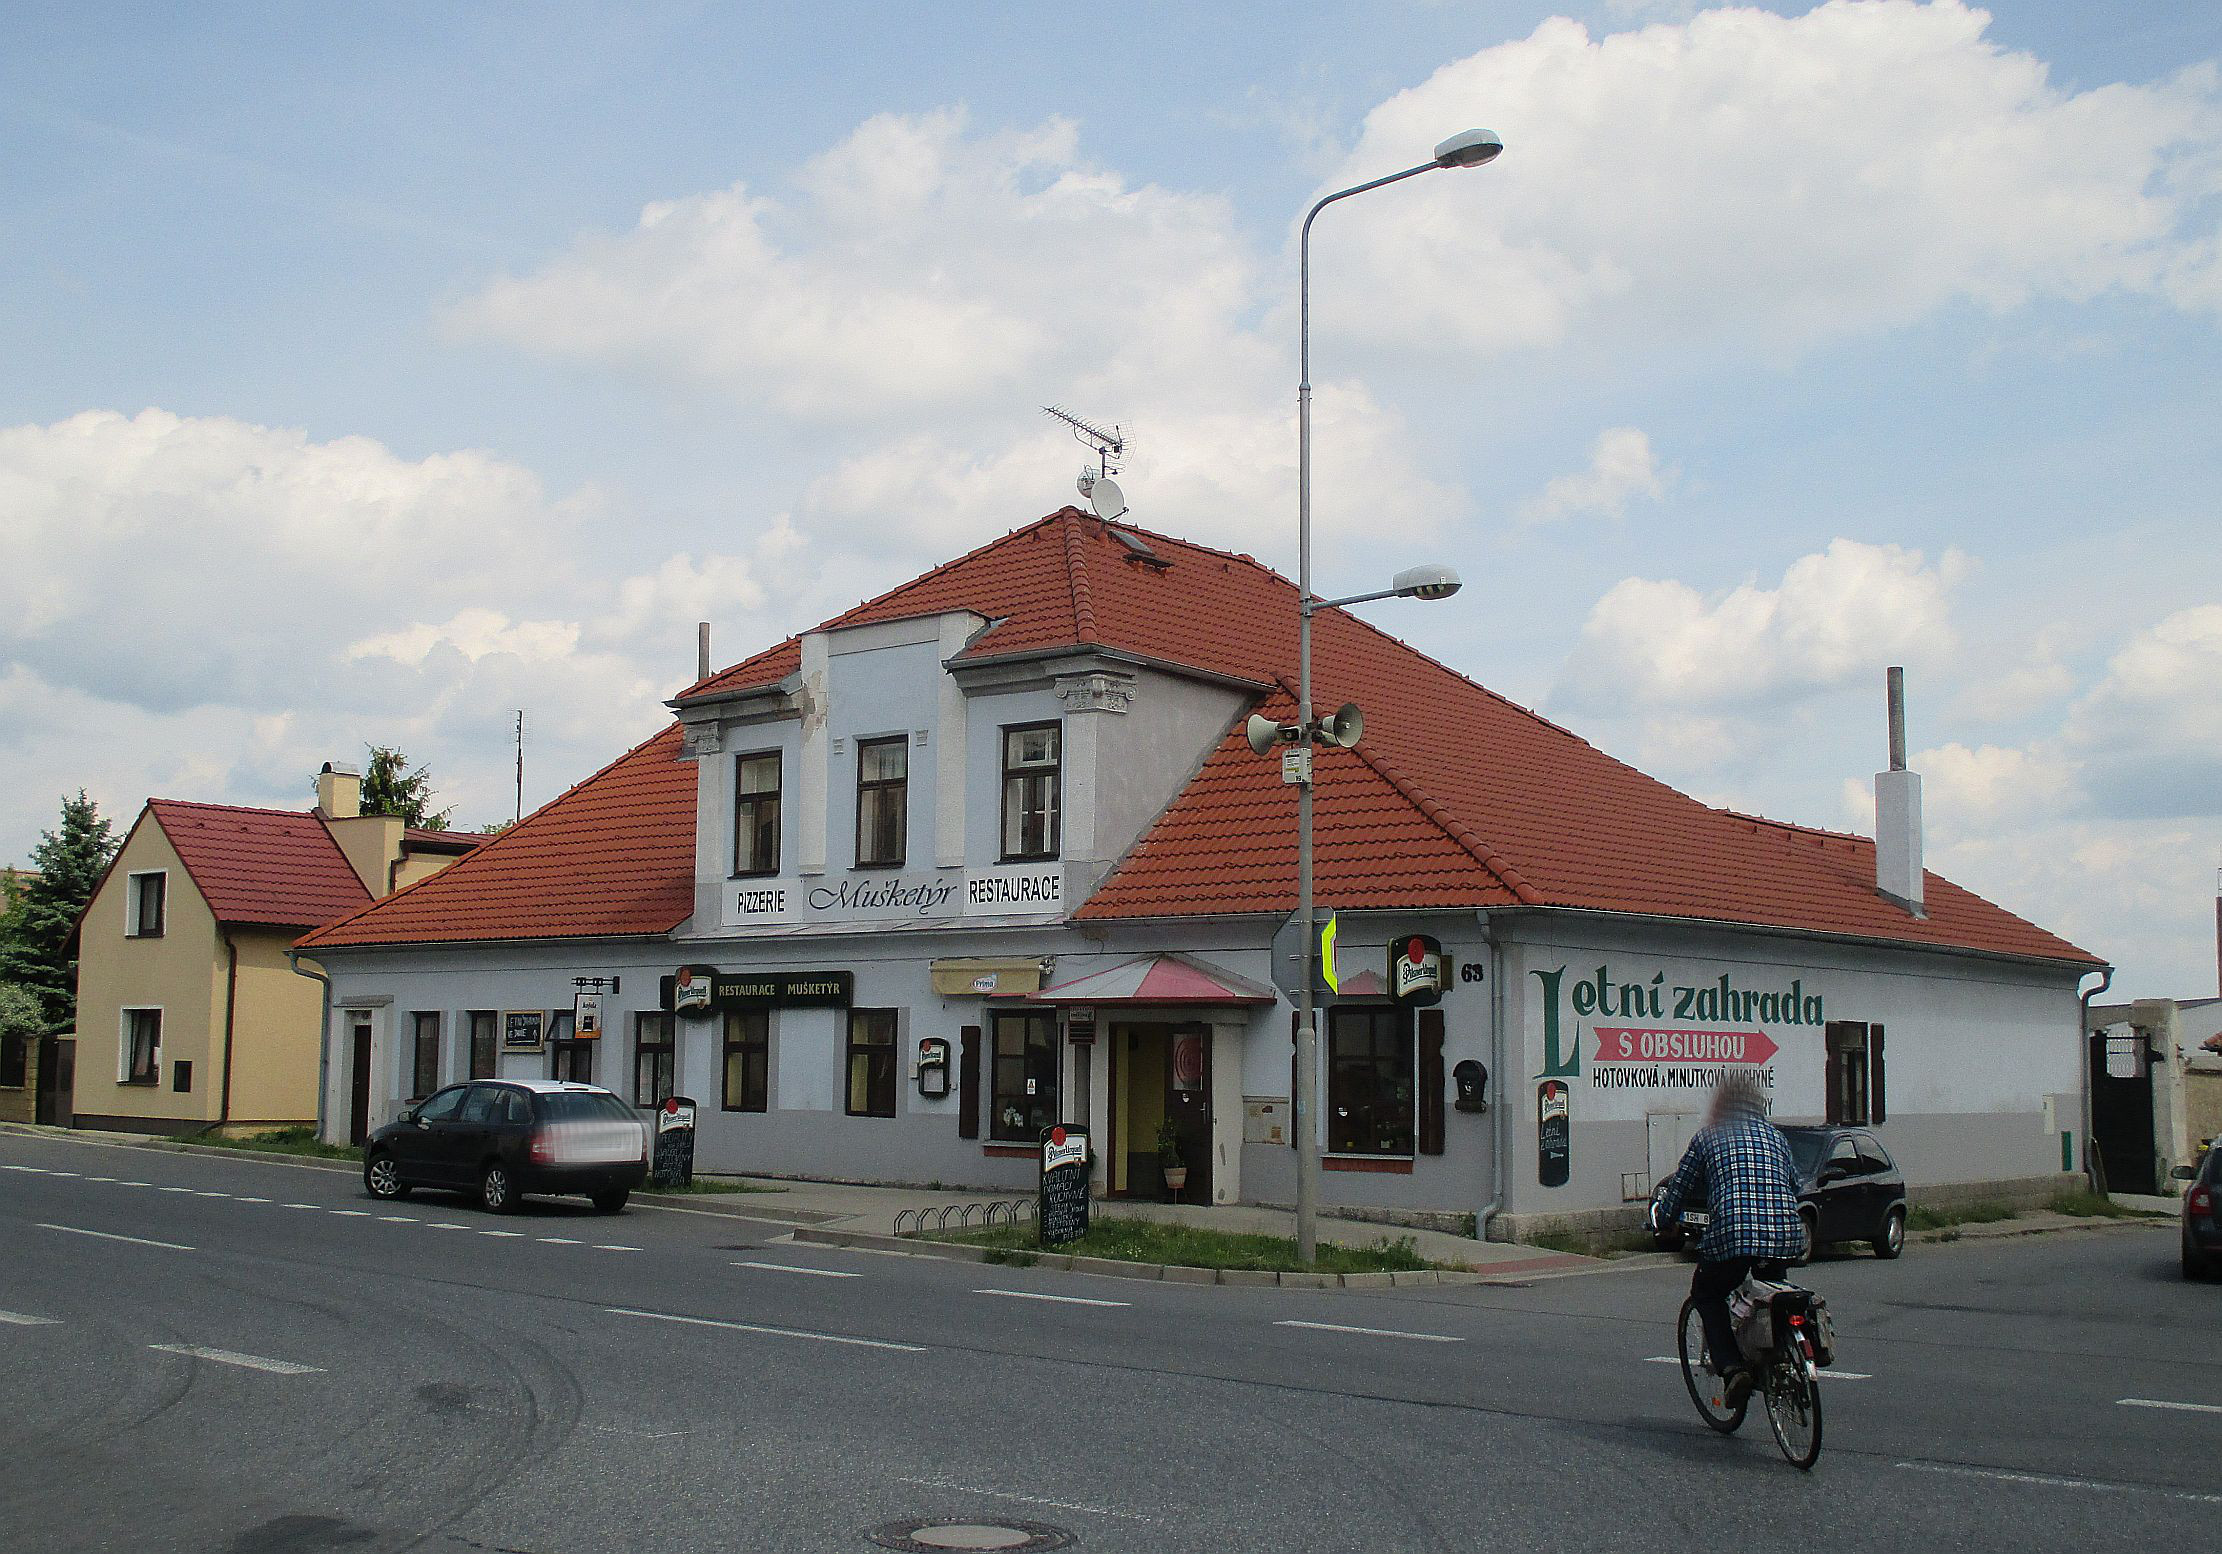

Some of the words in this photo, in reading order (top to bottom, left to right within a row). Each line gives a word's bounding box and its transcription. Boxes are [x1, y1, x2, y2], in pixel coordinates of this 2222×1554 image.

[737, 889, 786, 914] PIZZERIE
[808, 878, 957, 915] Mušketýr
[969, 875, 1060, 904] RESTAURACE
[1461, 963, 1484, 983] 63
[719, 984, 775, 997] RESTAURACE
[787, 981, 840, 995] MUŠKETÝR
[1529, 964, 1665, 1080] Letní
[1673, 973, 1824, 1026] zahrada
[1618, 1031, 1633, 1058] S
[1640, 1032, 1745, 1059] OBSLUHOU
[1593, 1064, 1659, 1088] HOTOVKOVÁ
[1667, 1064, 1726, 1088] MINUTKOVÁ
